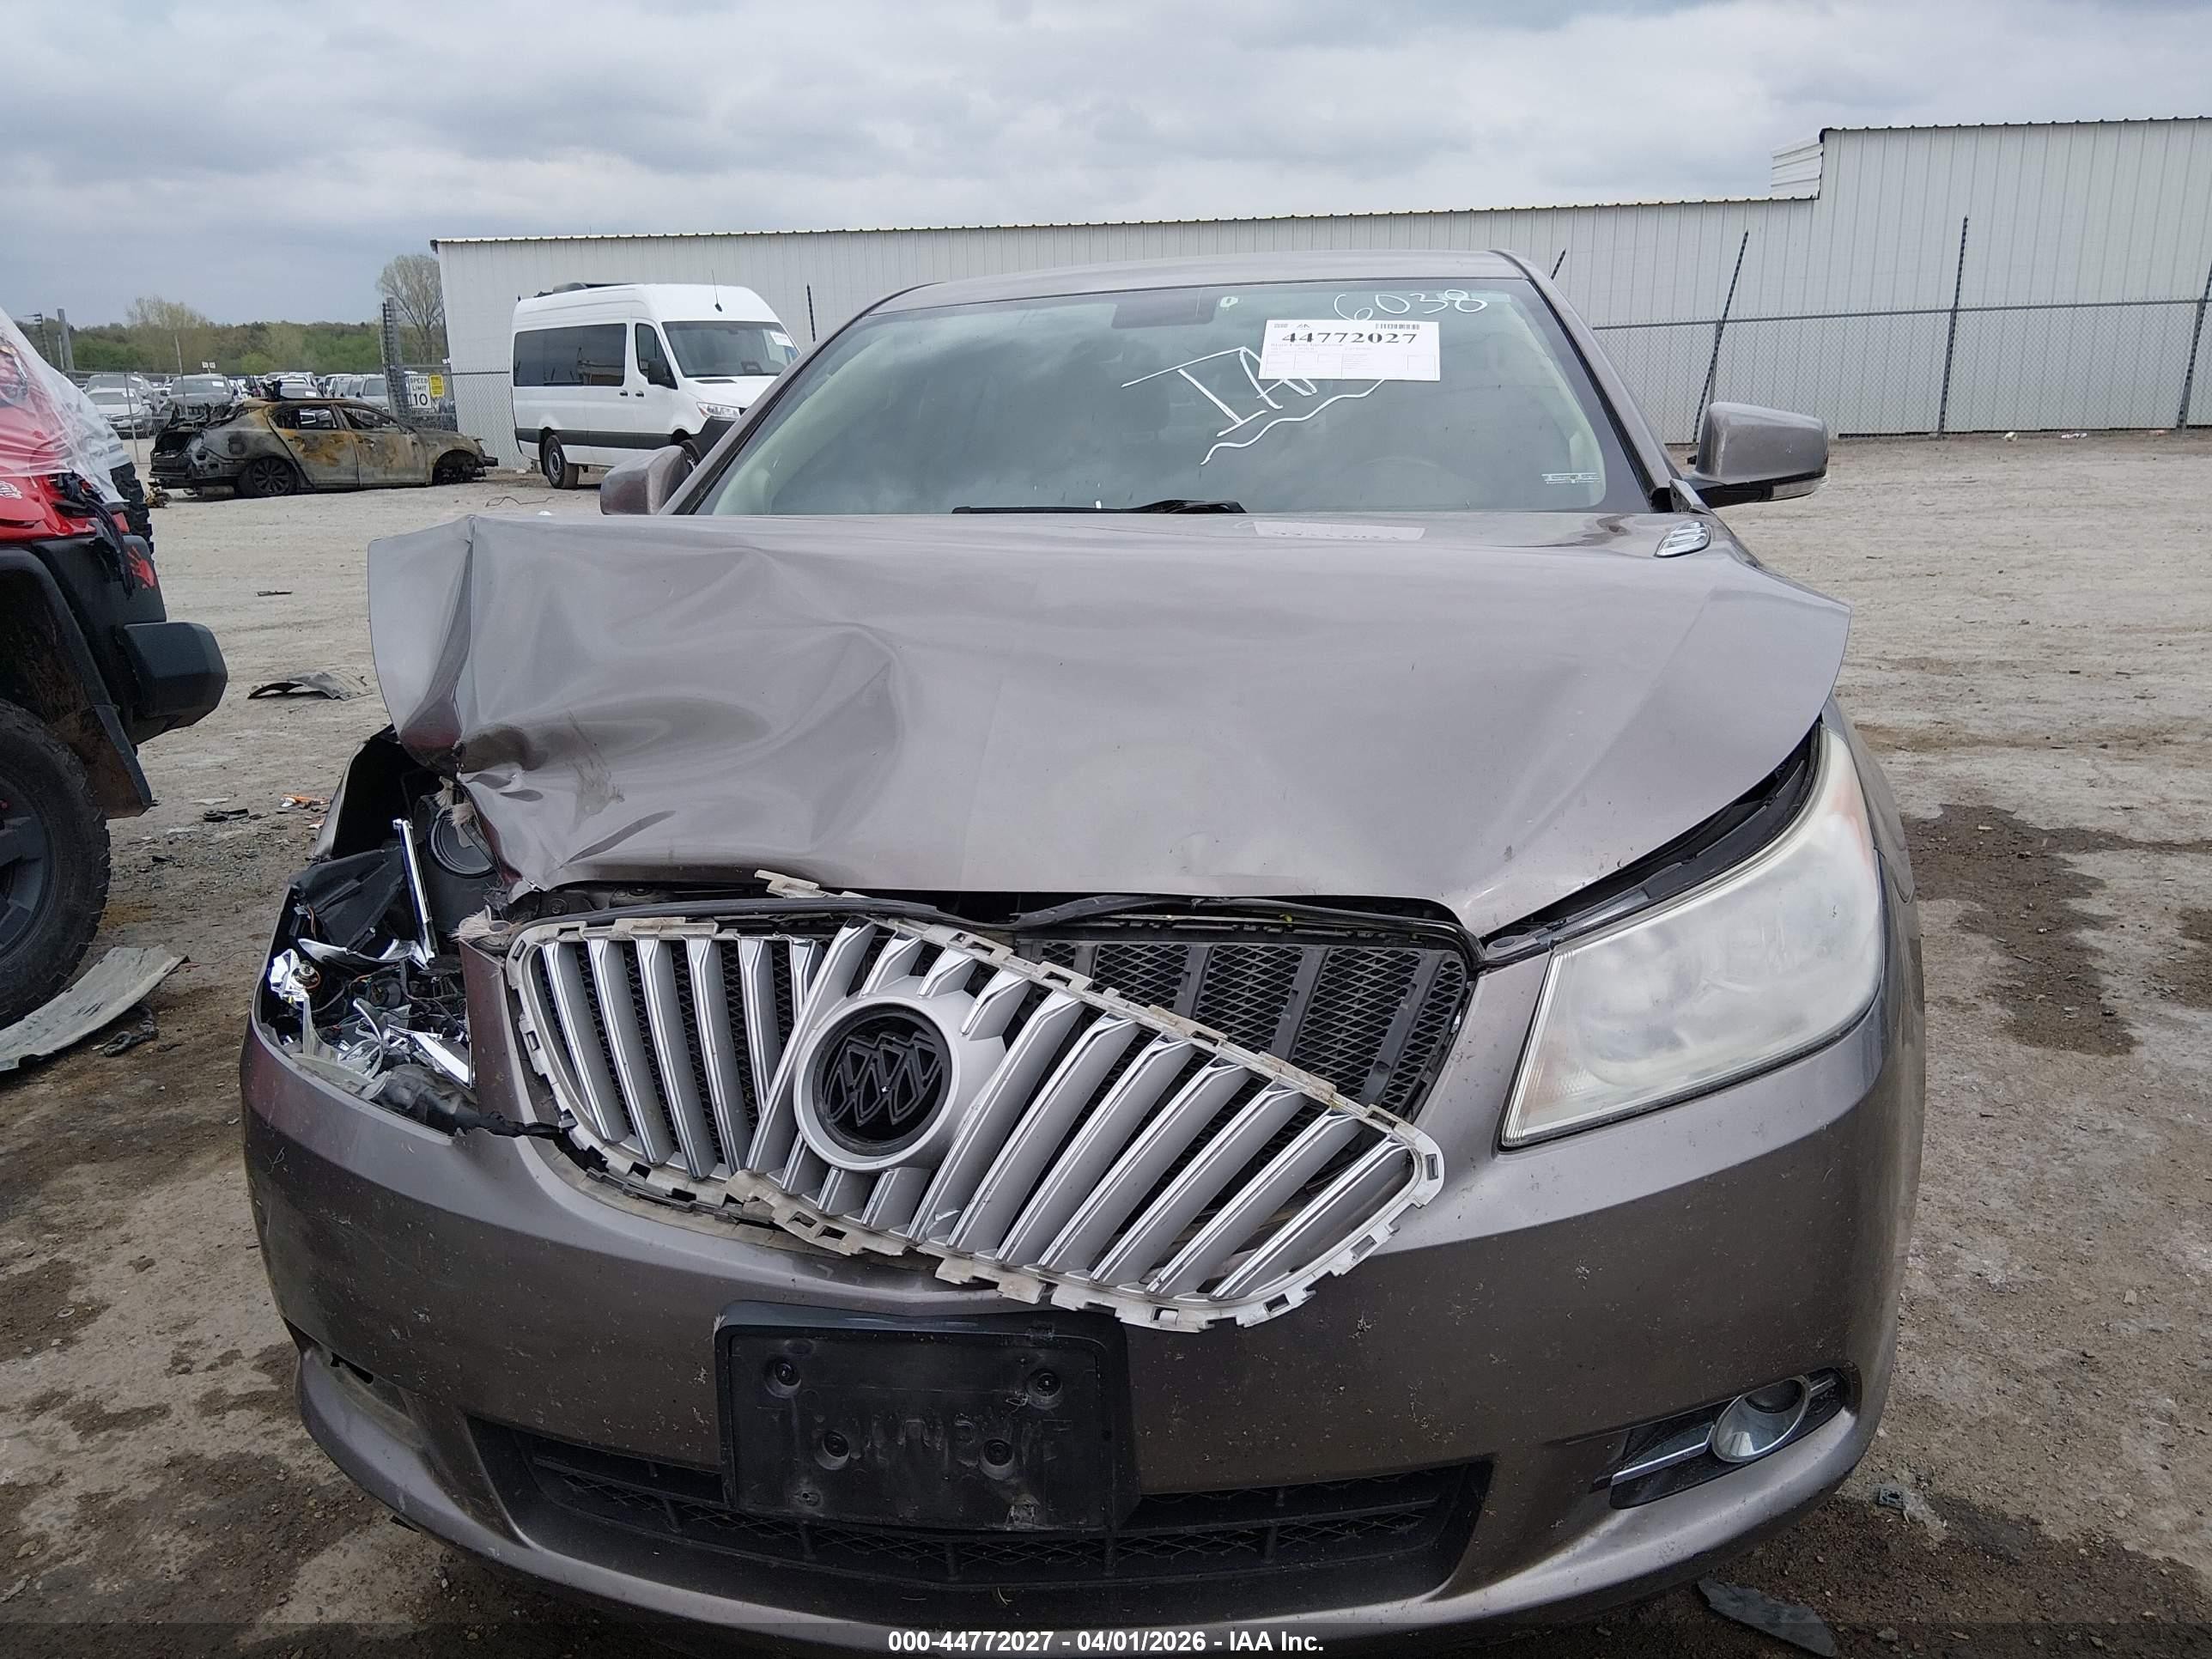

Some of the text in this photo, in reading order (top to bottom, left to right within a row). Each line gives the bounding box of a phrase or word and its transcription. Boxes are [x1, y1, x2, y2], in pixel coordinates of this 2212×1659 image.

[1334, 289, 1488, 321] 6038
[1281, 331, 1418, 344] 44772027
[413, 393, 428, 406] 10
